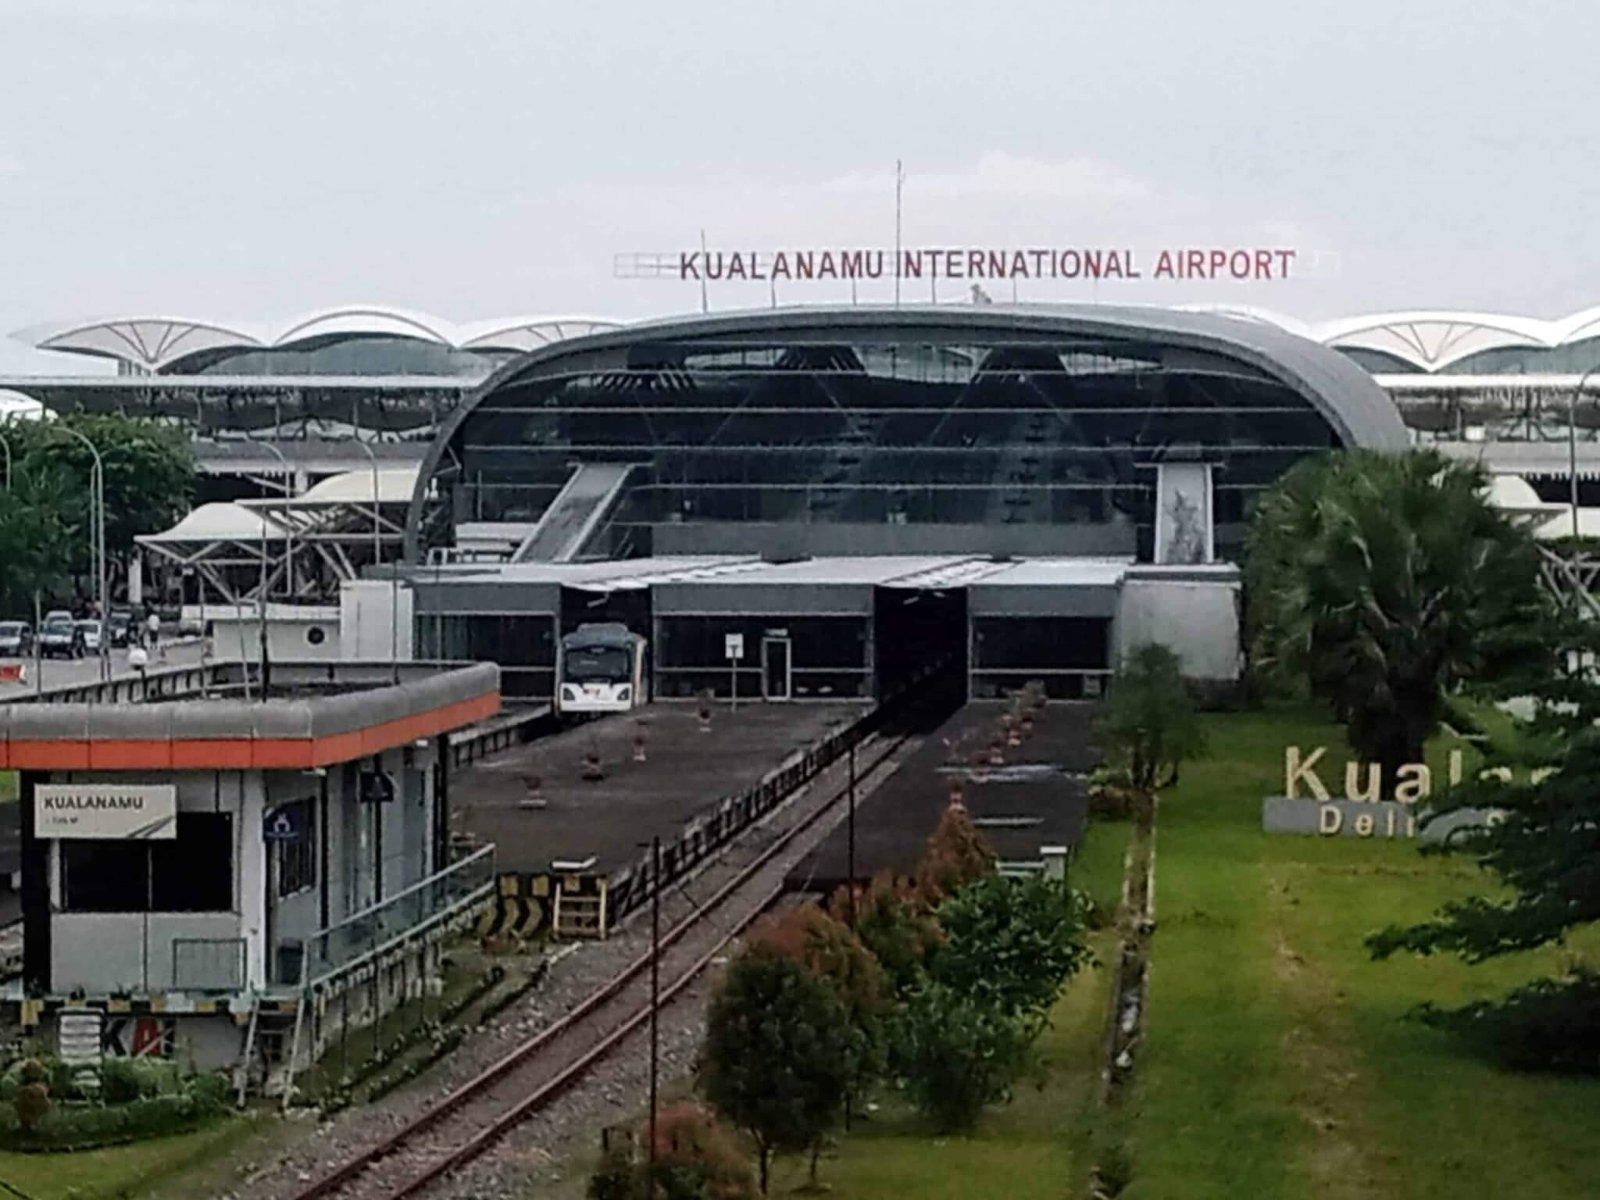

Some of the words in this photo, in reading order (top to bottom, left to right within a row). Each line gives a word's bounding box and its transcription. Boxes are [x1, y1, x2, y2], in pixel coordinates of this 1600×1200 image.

[680, 250, 883, 279] KUALANAMU
[896, 249, 1141, 278] INTERNATIONAL
[1154, 249, 1296, 278] AIRPORT
[44, 795, 144, 810] KUALANAMU
